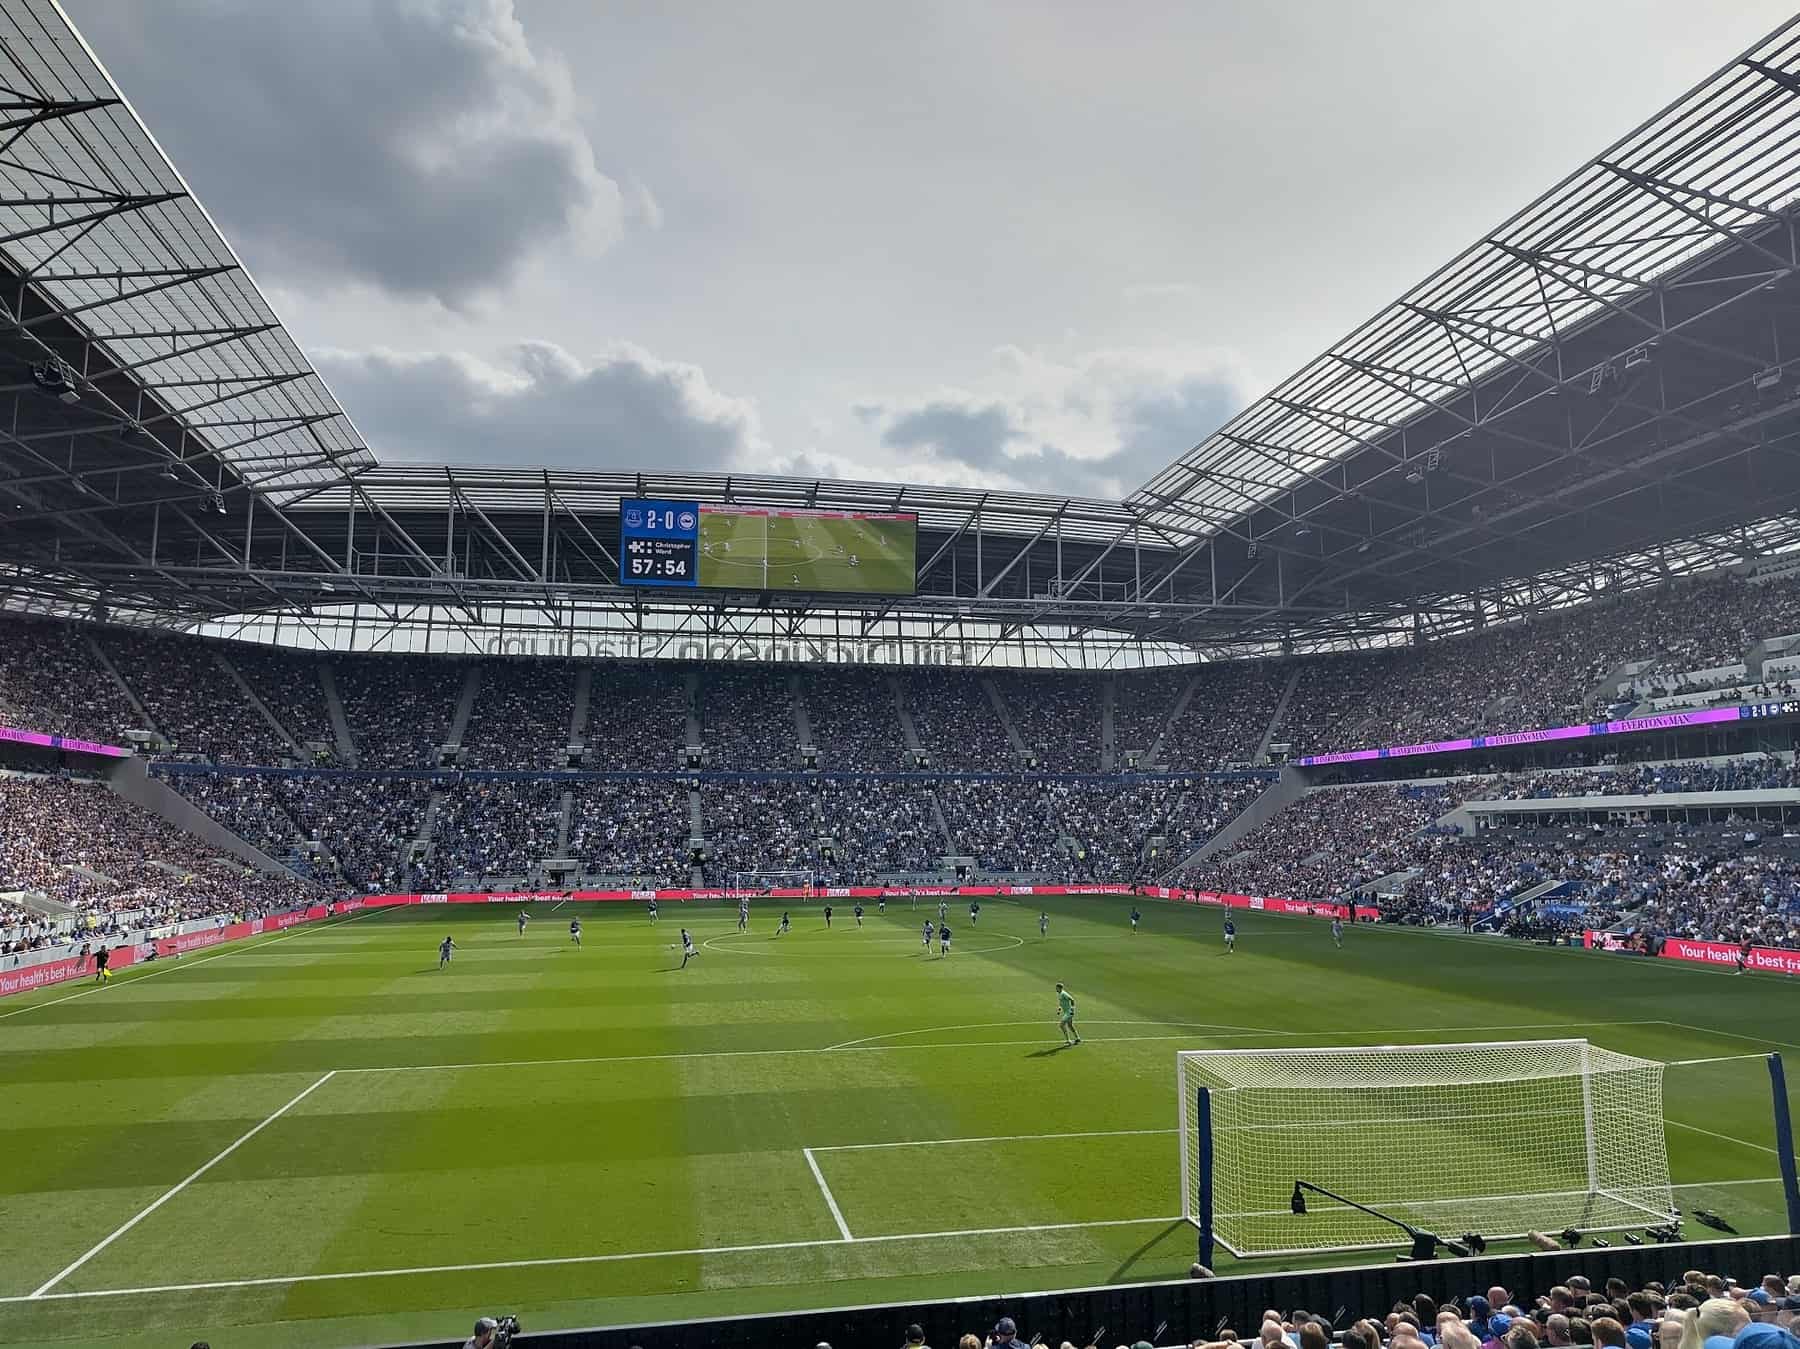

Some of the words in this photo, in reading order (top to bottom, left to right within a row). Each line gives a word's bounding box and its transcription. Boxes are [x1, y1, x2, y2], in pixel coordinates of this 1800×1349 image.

[647, 510, 674, 530] 2-0
[632, 559, 686, 575] 57:54
[1680, 944, 1705, 959] Your
[1707, 947, 1753, 964] healts
[1757, 951, 1785, 968] best
[0, 978, 20, 992] Your
[20, 970, 49, 988] health's
[50, 966, 65, 980] best
